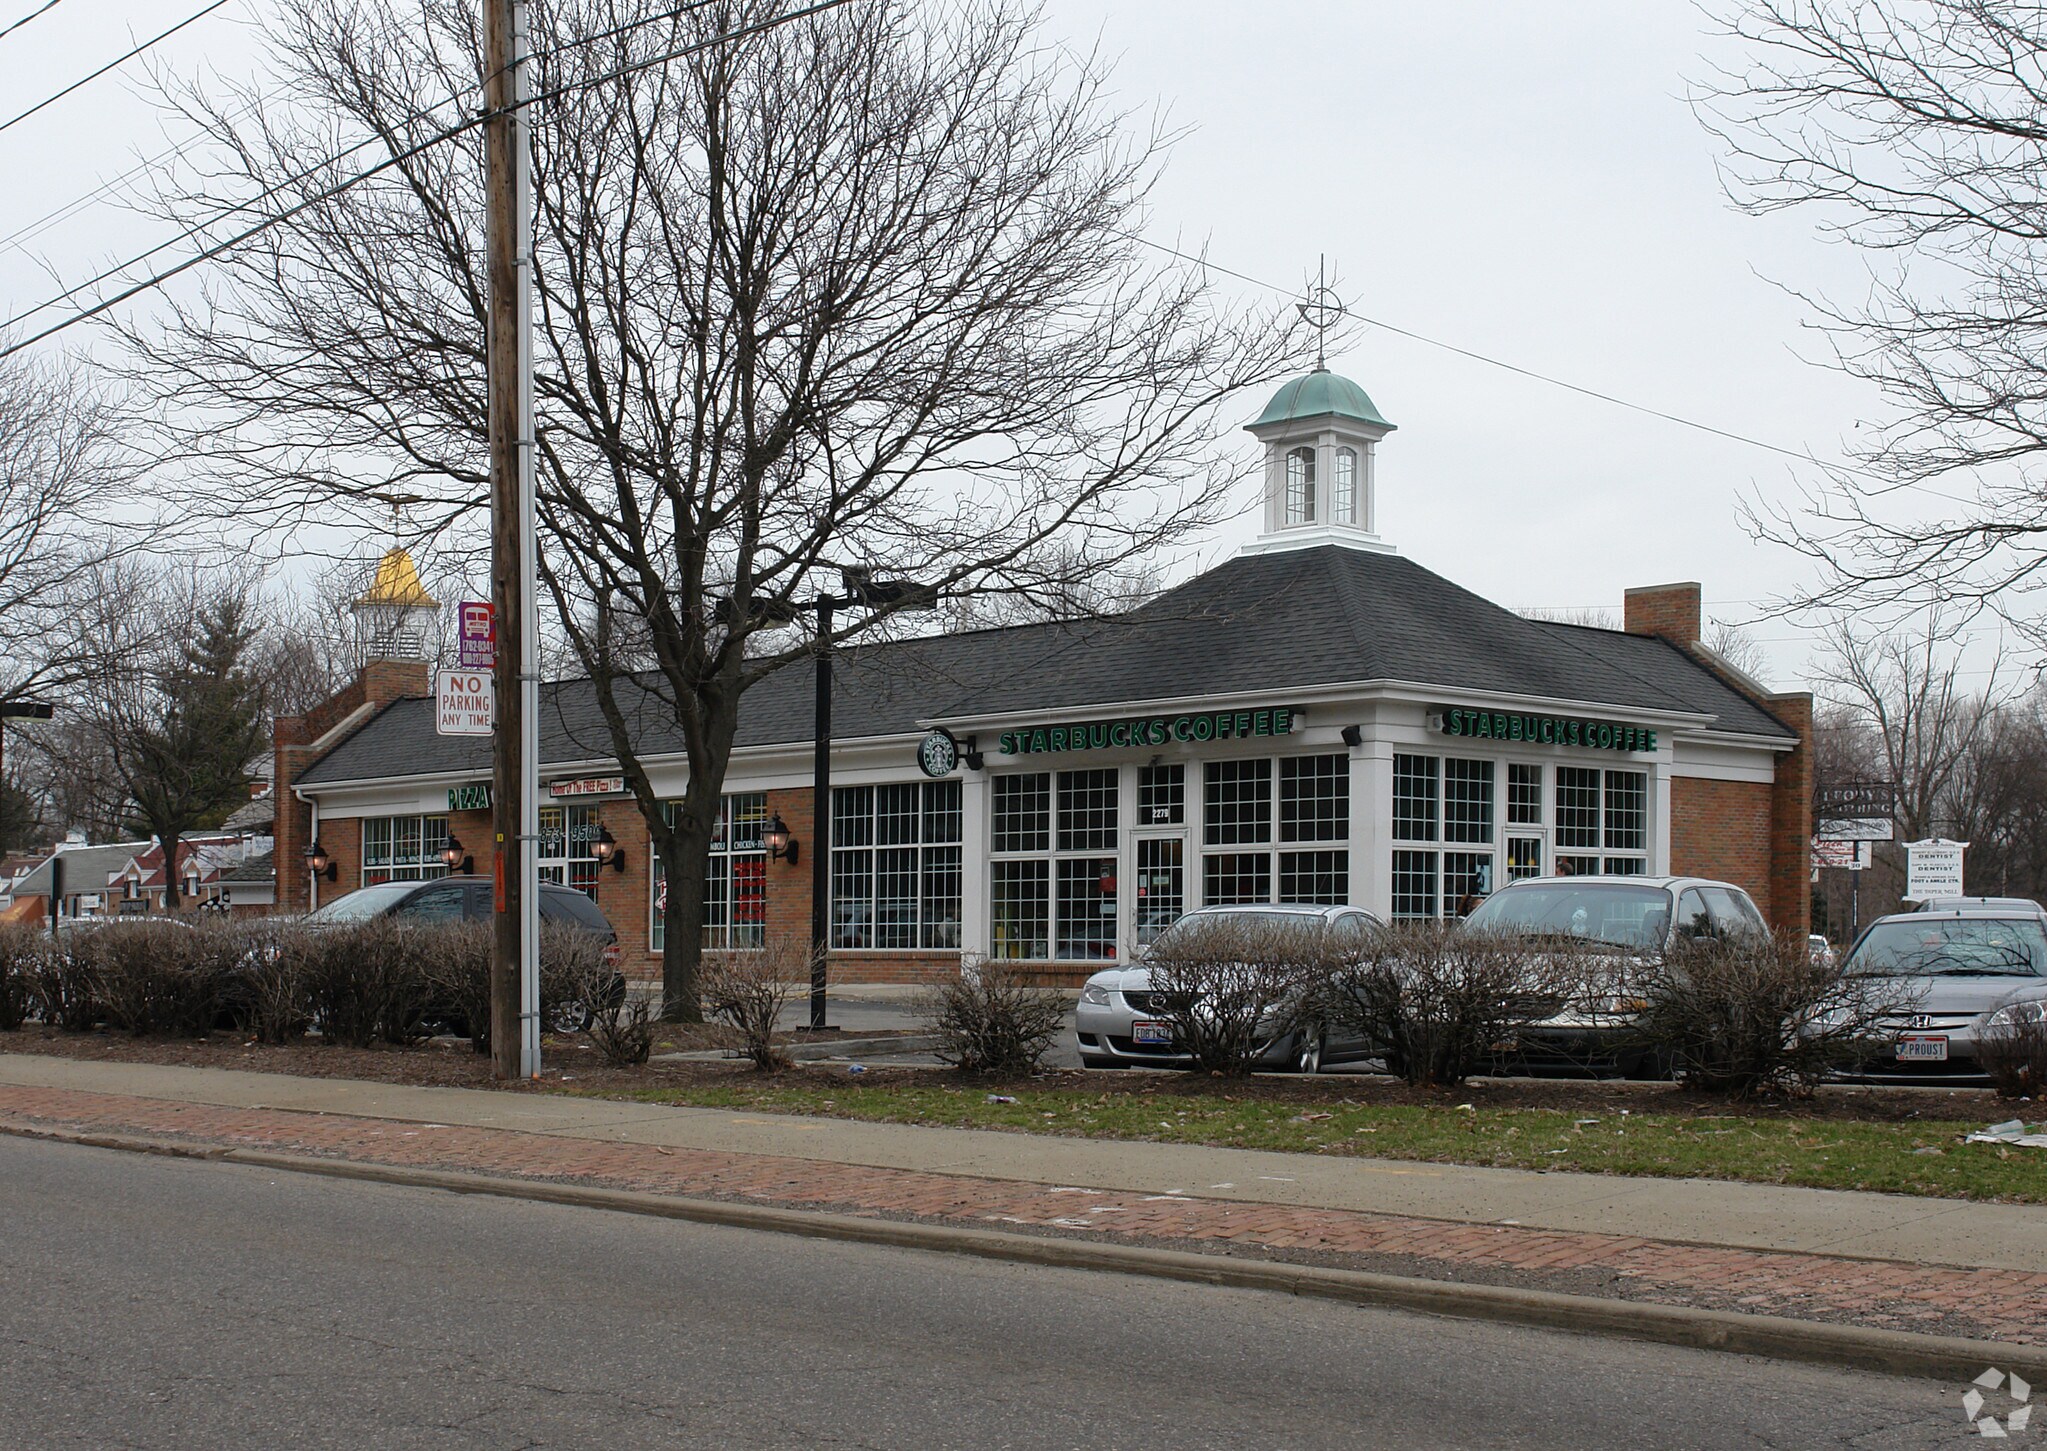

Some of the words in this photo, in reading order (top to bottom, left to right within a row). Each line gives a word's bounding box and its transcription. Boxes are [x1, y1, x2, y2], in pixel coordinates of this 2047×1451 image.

[450, 676, 481, 693] NO
[442, 695, 490, 712] PARKING
[442, 714, 461, 726] ANY
[468, 714, 490, 727] TIME
[999, 718, 1168, 756] STARBUCKS
[1172, 708, 1291, 743] COFFEE
[1449, 708, 1580, 747] STARBUCKS
[1584, 722, 1658, 752] COFFEE
[924, 735, 954, 755] STARBUCKS
[929, 763, 950, 775] COFFEE
[583, 779, 596, 792] FREE
[447, 785, 490, 811] PIZZA
[1152, 808, 1169, 818] 2279
[1909, 1043, 1944, 1056] PROUST
